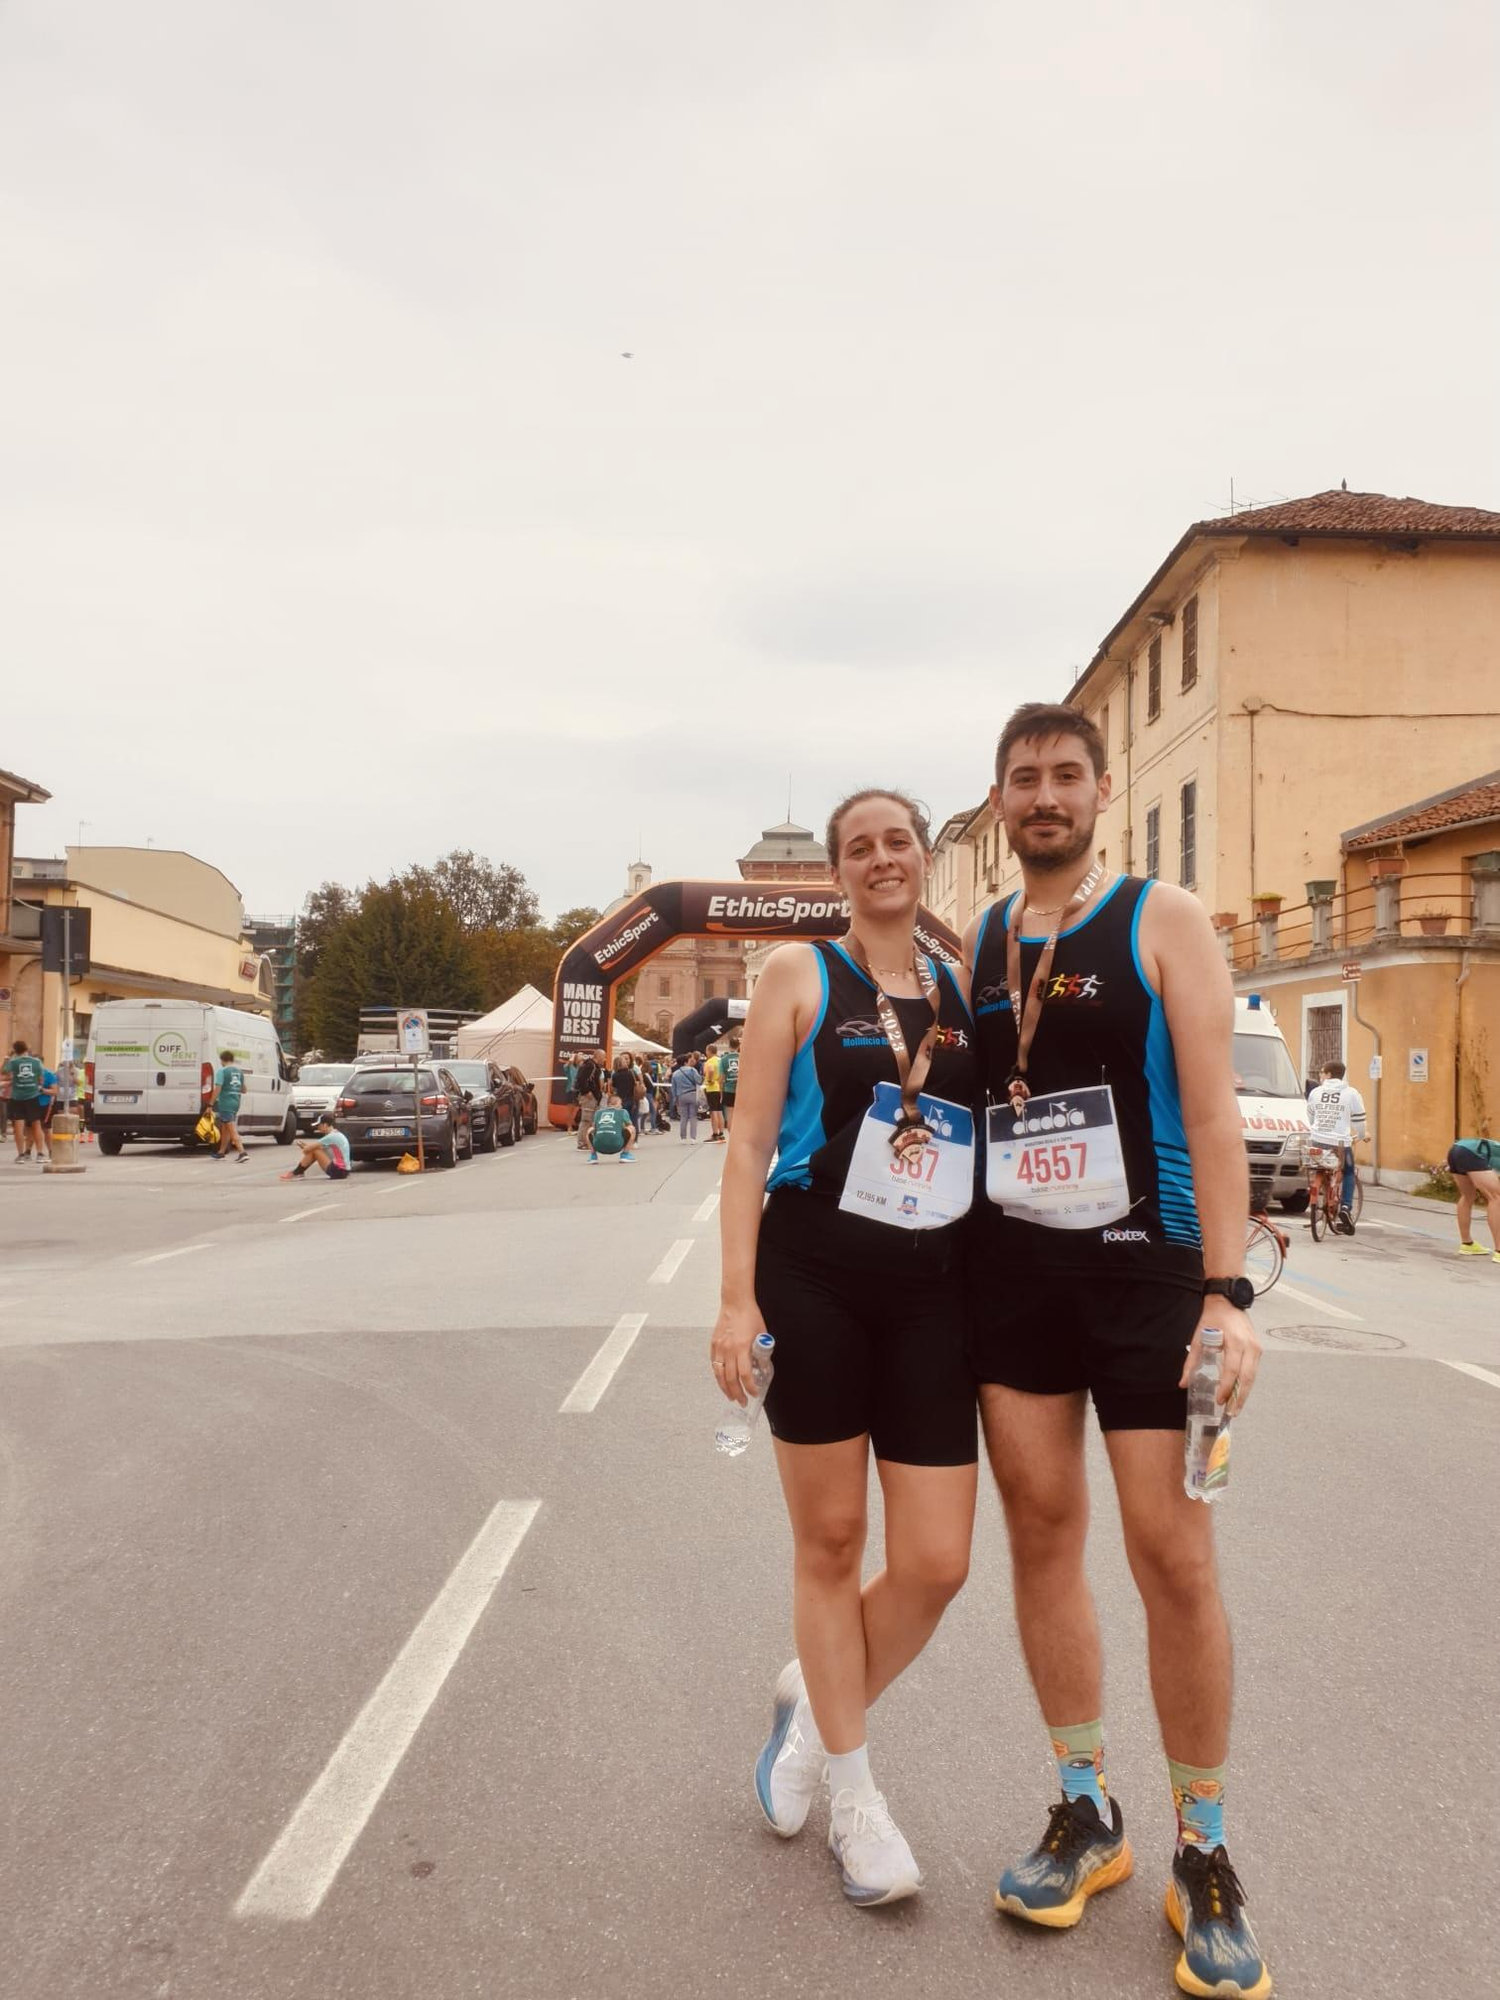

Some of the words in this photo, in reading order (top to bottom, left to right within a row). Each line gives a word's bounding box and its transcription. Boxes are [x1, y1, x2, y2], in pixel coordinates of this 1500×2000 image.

[707, 896, 852, 923] EthicSport
[594, 912, 660, 964] EthicSport
[563, 983, 603, 1001] MAKE
[562, 1001, 602, 1018] YOUR
[562, 1018, 600, 1036] BEST
[880, 1008, 905, 1051] 2023
[159, 1044, 182, 1053] DIFF
[172, 1051, 198, 1060] RENT
[1320, 1092, 1341, 1104] 85
[1012, 1103, 1086, 1134] diadora
[1016, 1142, 1087, 1185] 4557
[1102, 1229, 1150, 1244] footex
